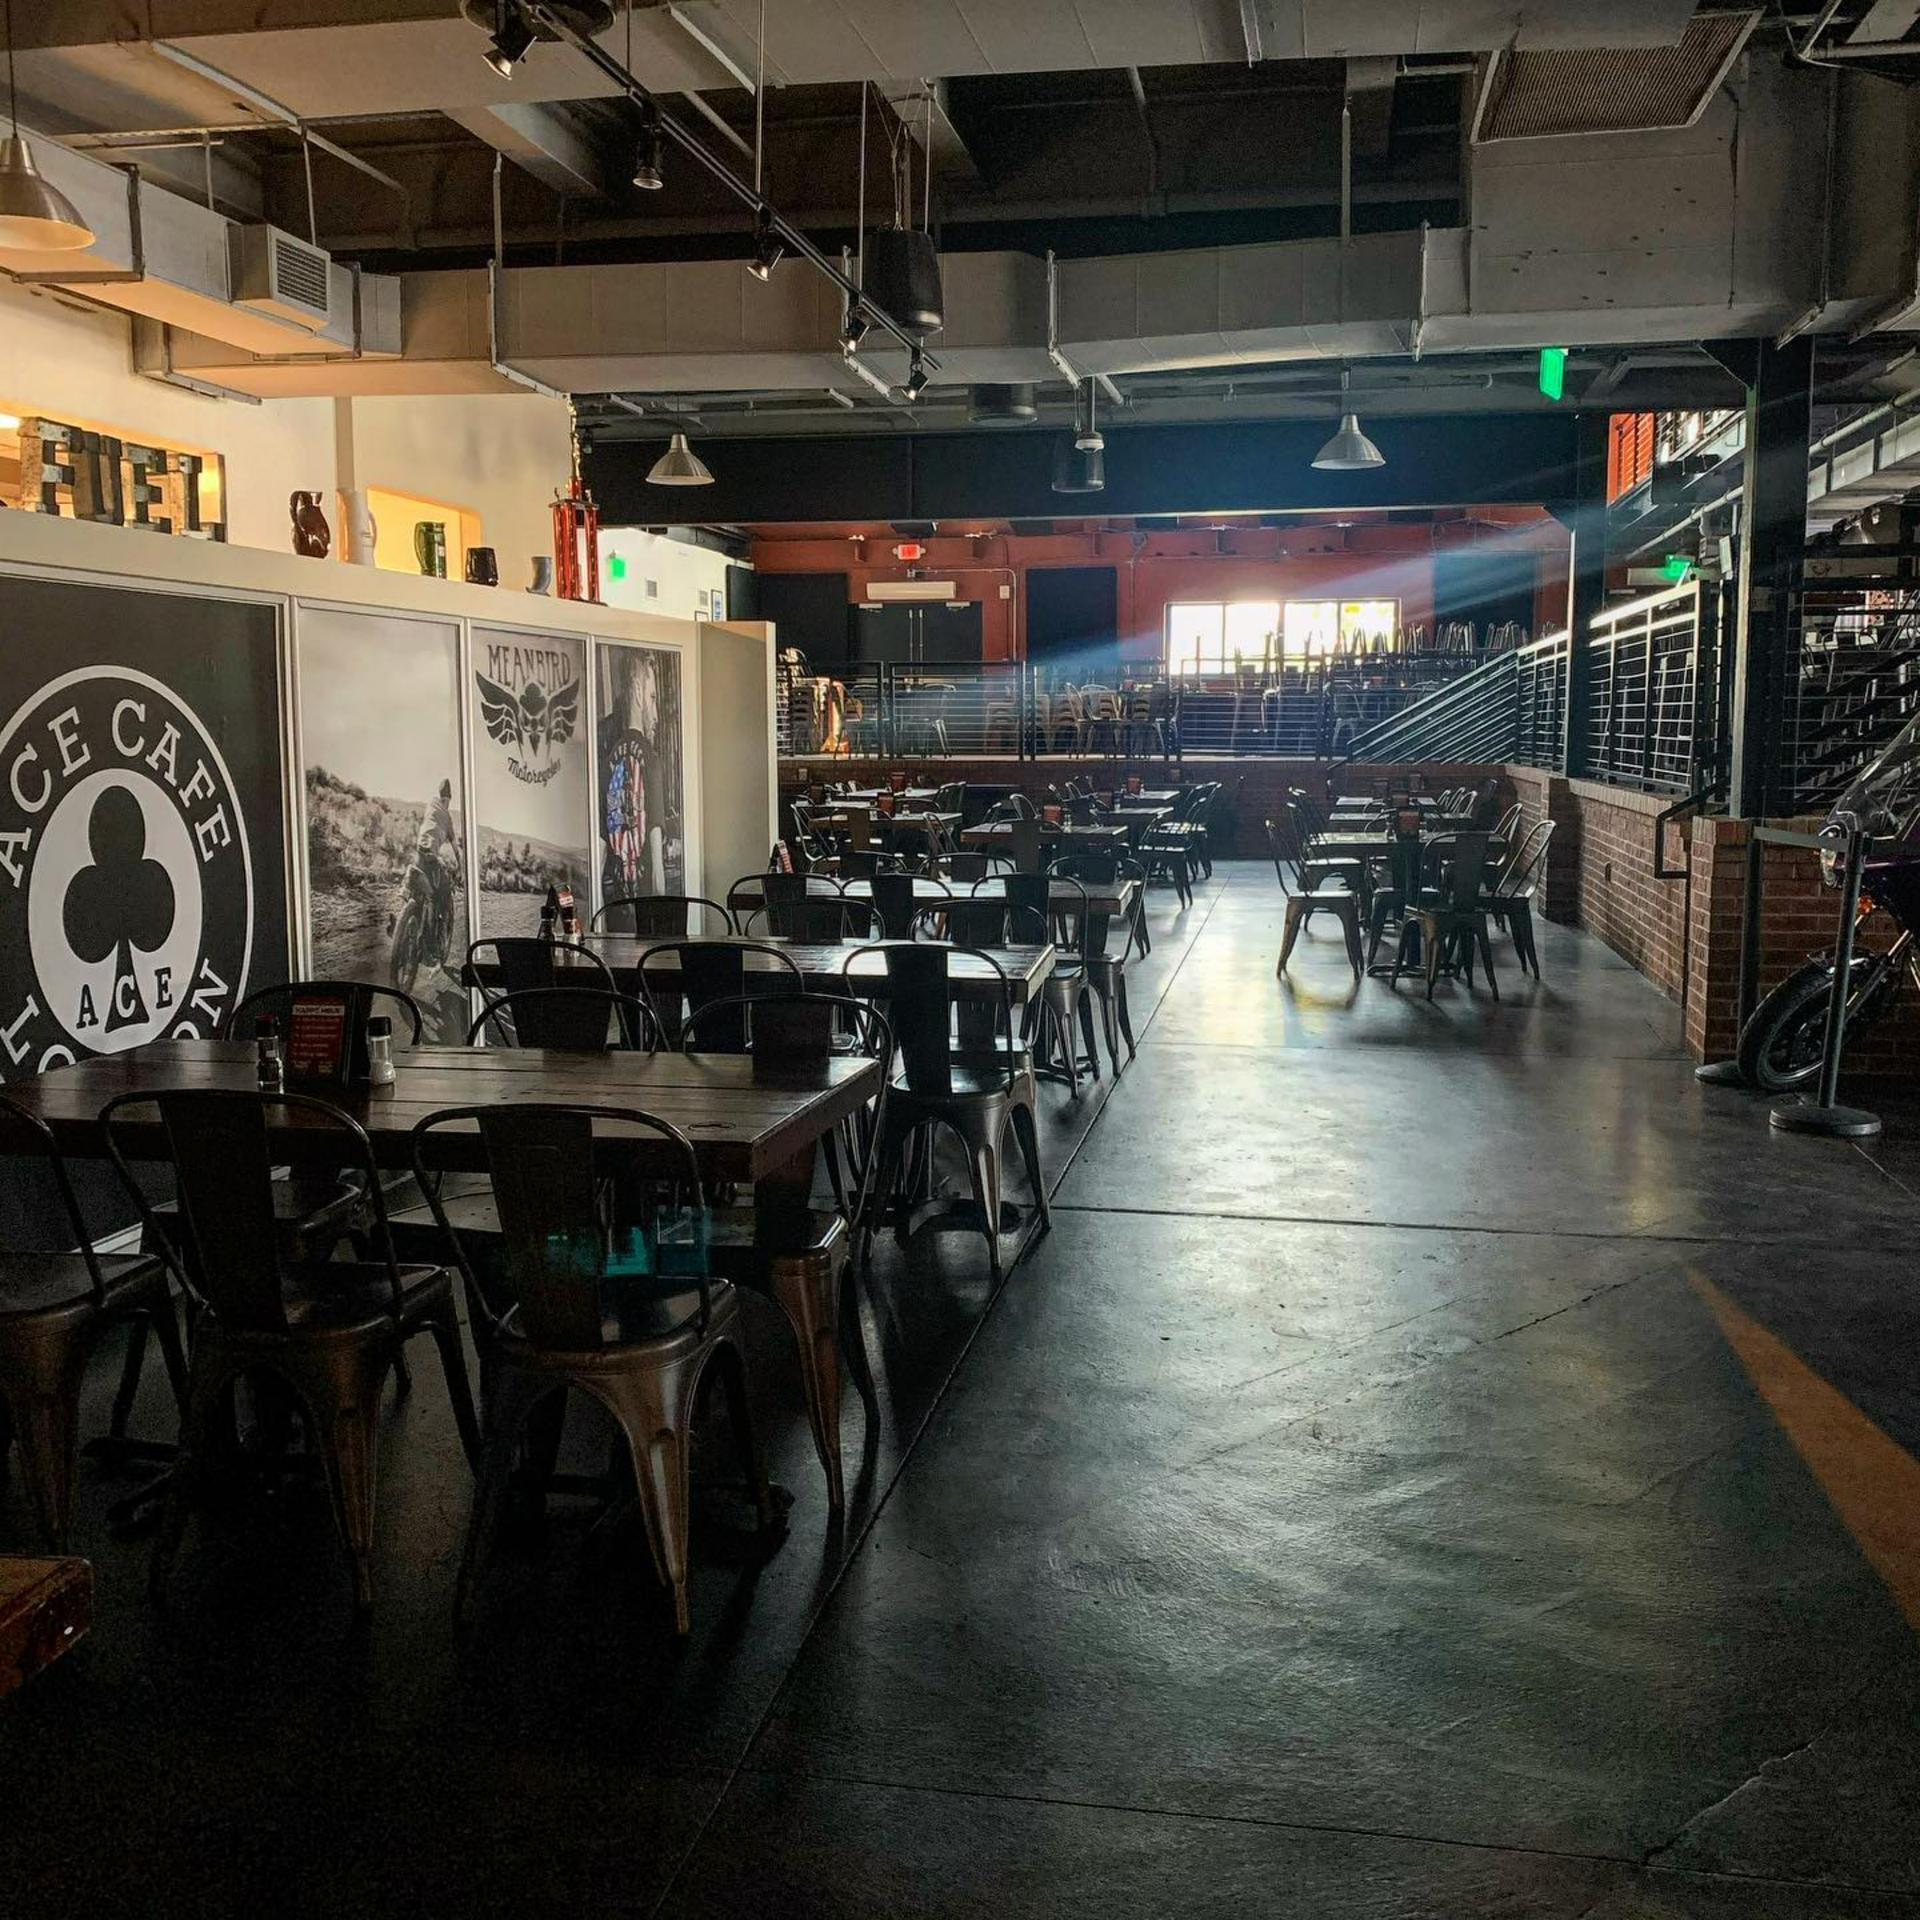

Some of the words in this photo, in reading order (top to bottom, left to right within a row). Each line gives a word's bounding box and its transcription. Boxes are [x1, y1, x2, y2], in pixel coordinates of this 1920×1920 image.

[18, 416, 227, 542] FUEL
[0, 706, 91, 888] ACE
[113, 699, 231, 862] CAFE
[76, 967, 173, 1028] ACE
